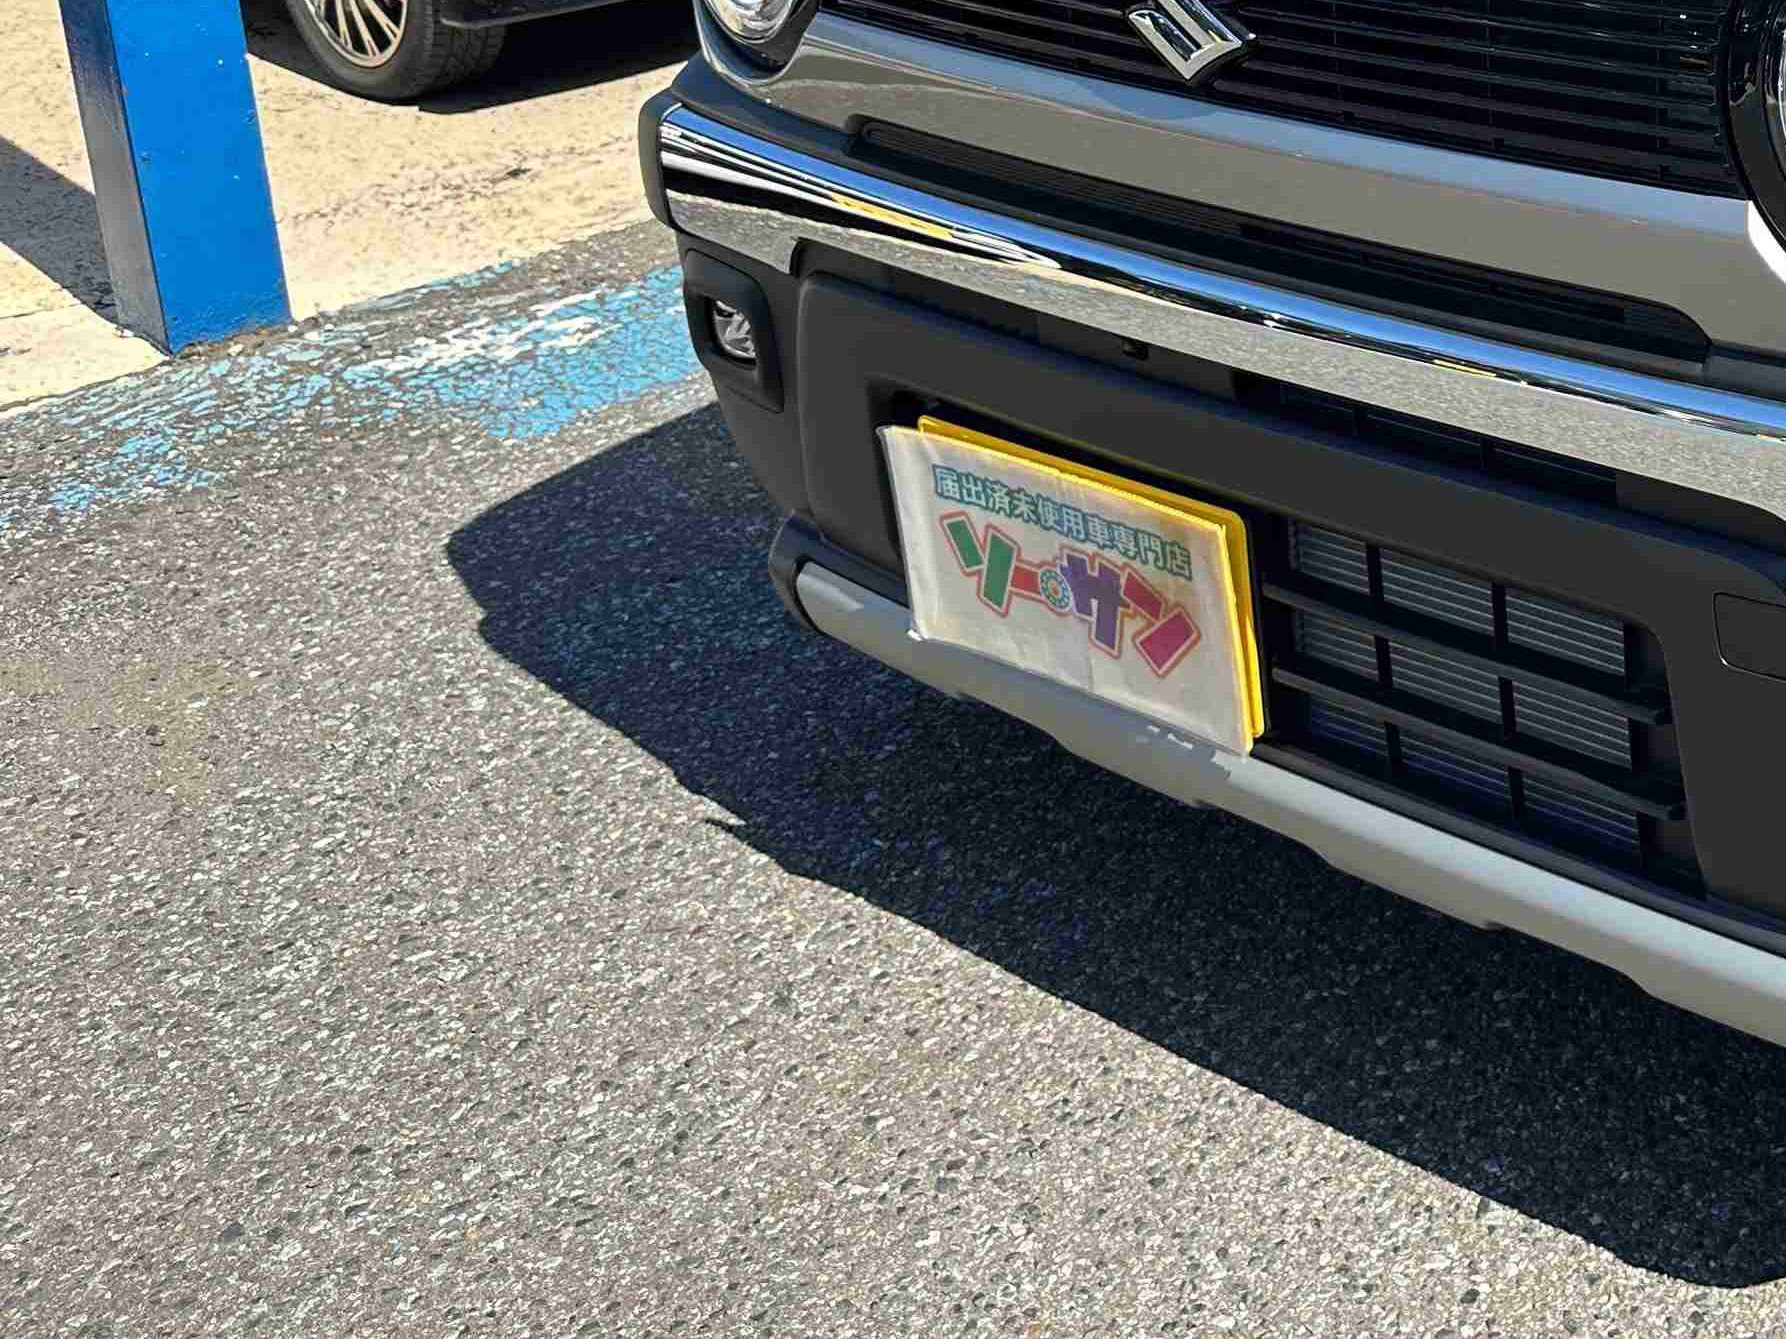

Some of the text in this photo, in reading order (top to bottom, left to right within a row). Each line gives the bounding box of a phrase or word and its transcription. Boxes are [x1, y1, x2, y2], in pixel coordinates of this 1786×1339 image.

[931, 463, 1193, 582] 届出済未使用車専門店
